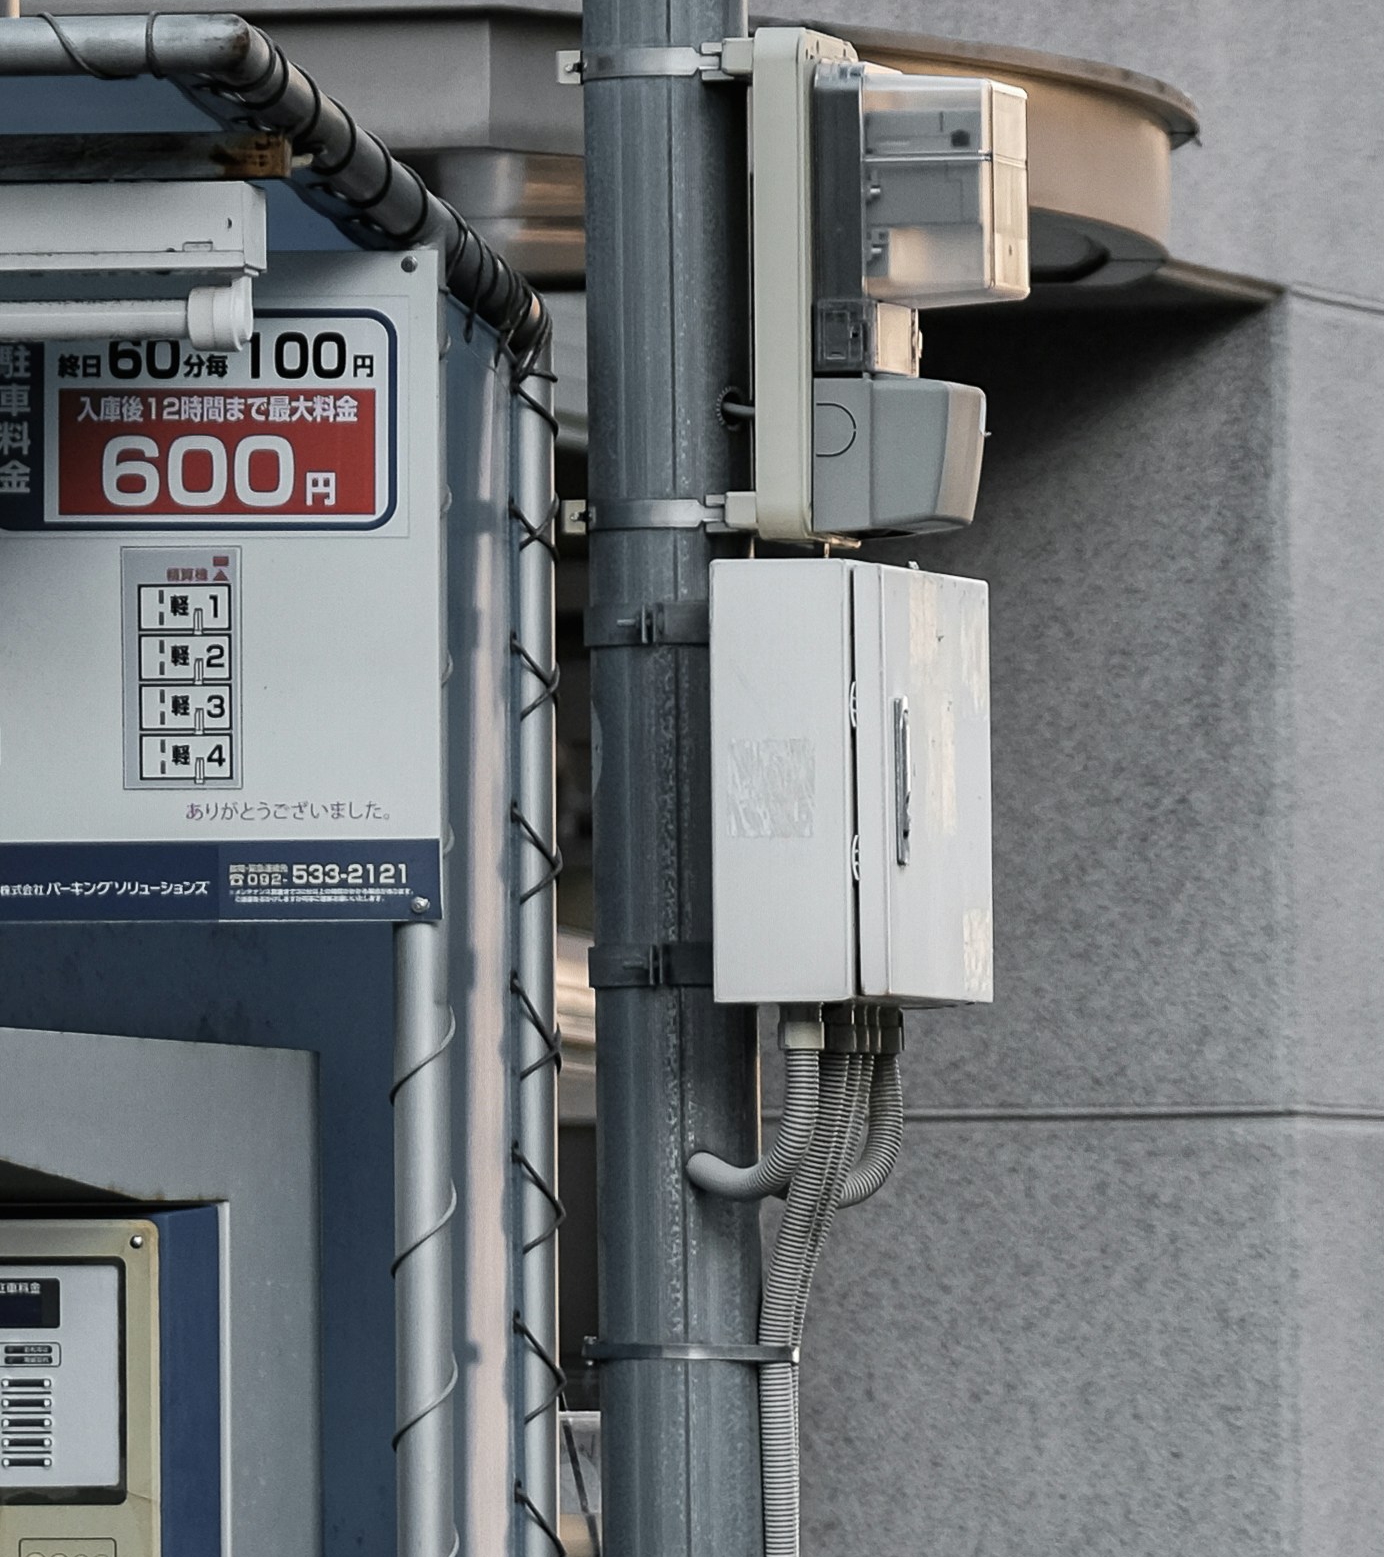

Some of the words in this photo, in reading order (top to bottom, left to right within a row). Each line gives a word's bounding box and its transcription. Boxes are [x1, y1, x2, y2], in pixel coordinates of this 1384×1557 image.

[77, 395, 358, 423] 入庫後12時間まで最大料金
[186, 801, 390, 821] ありがとうございました。
